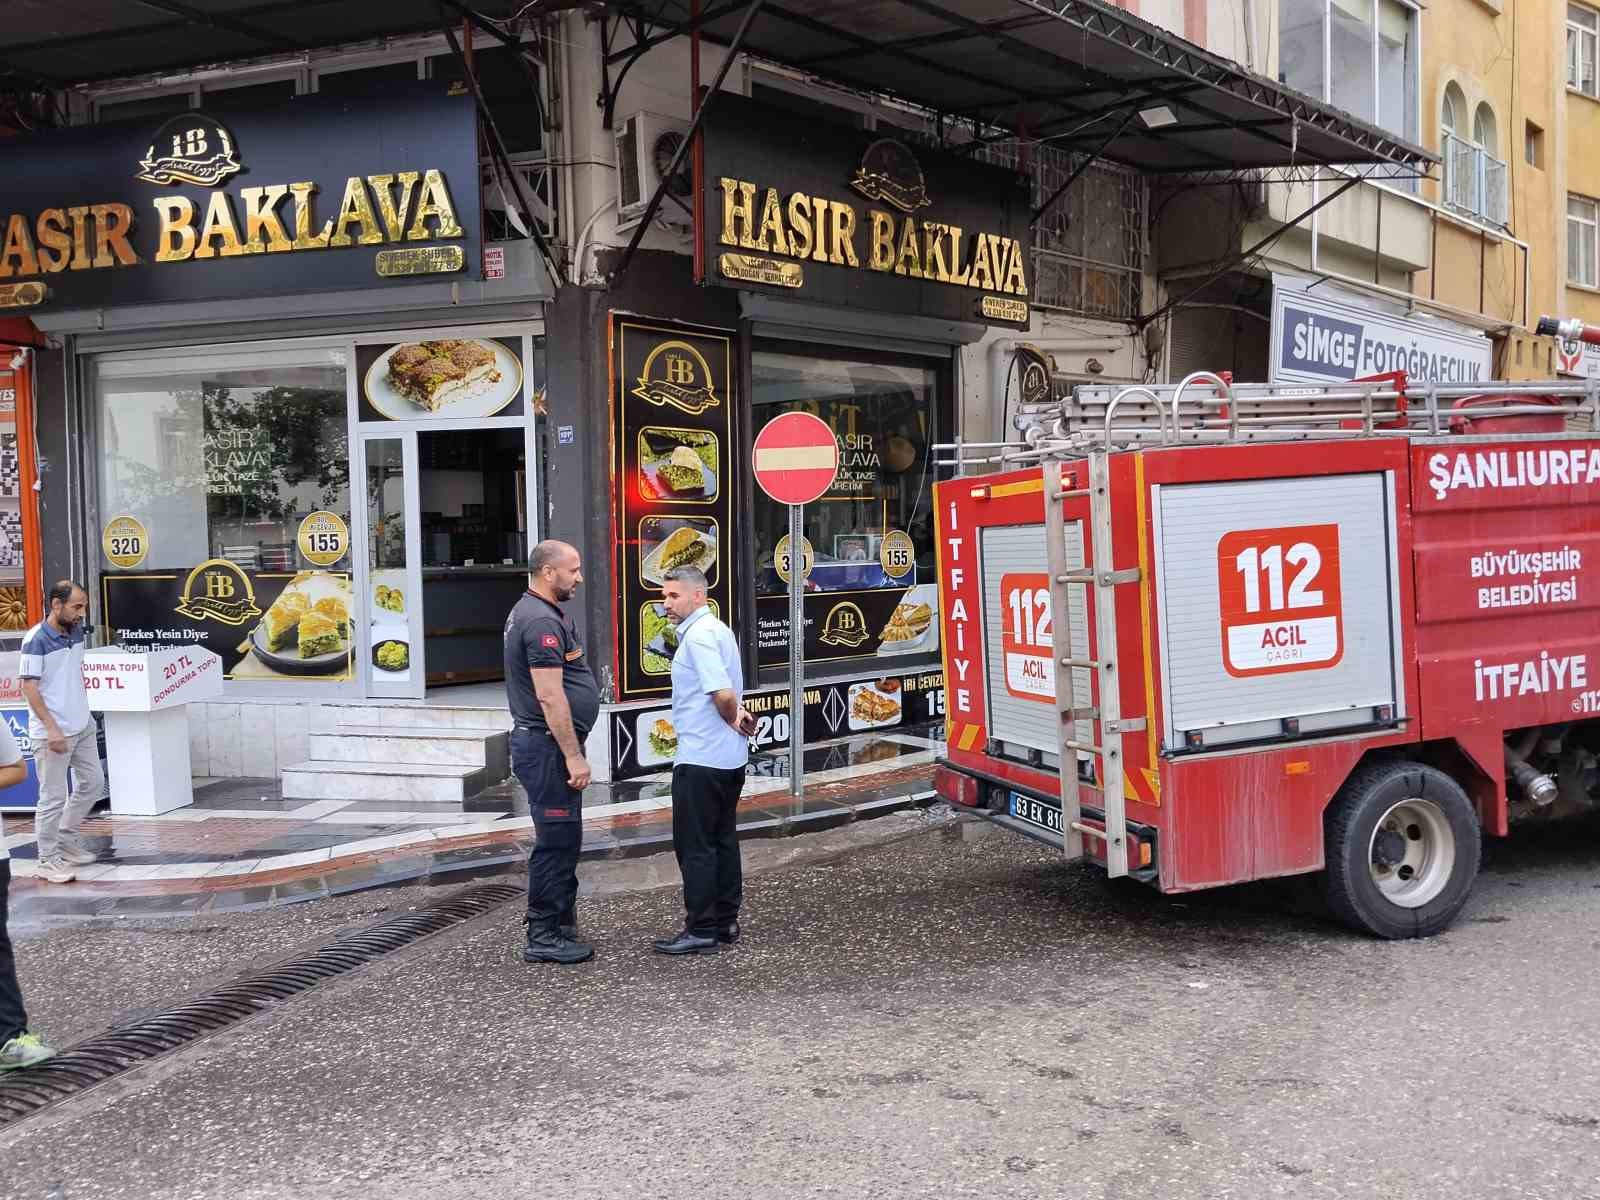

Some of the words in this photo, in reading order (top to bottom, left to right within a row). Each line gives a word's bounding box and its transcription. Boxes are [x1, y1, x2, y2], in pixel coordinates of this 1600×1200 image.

[154, 169, 464, 262] BAKLAVA
[719, 177, 858, 267] HASIR
[870, 209, 1028, 296] BAKLAVA
[1293, 317, 1355, 369] SİMGE
[201, 431, 256, 449] ASIR
[835, 434, 873, 450] ASIR
[205, 451, 267, 467] KLAVA
[838, 453, 881, 467] KLAVA
[1429, 449, 1600, 499] ŞANLIURFA
[111, 537, 140, 555] 320
[308, 533, 339, 552] 155
[782, 555, 807, 572] 30
[887, 550, 908, 566] 155
[1471, 545, 1581, 578] BÜYÜKŞEHİR
[204, 575, 235, 598] HB
[1236, 542, 1324, 614] 112
[1478, 575, 1577, 609] BELEDİYESİ
[948, 501, 971, 713] İTFAİYE
[1009, 587, 1054, 647] 112
[155, 628, 181, 640] Yesin
[82, 663, 117, 672] DURMA
[119, 663, 144, 672] TOPU
[153, 670, 198, 703] DONDURMA
[198, 656, 218, 674] TOPU
[163, 663, 177, 680] 20
[178, 655, 193, 670] TL
[1474, 651, 1587, 701] İTFAİYE
[84, 677, 100, 689] 20
[105, 677, 125, 689] TL
[744, 697, 772, 713] TIKLI
[757, 713, 790, 745] 20
[1016, 797, 1027, 816] 63
[1031, 803, 1043, 823] EK
